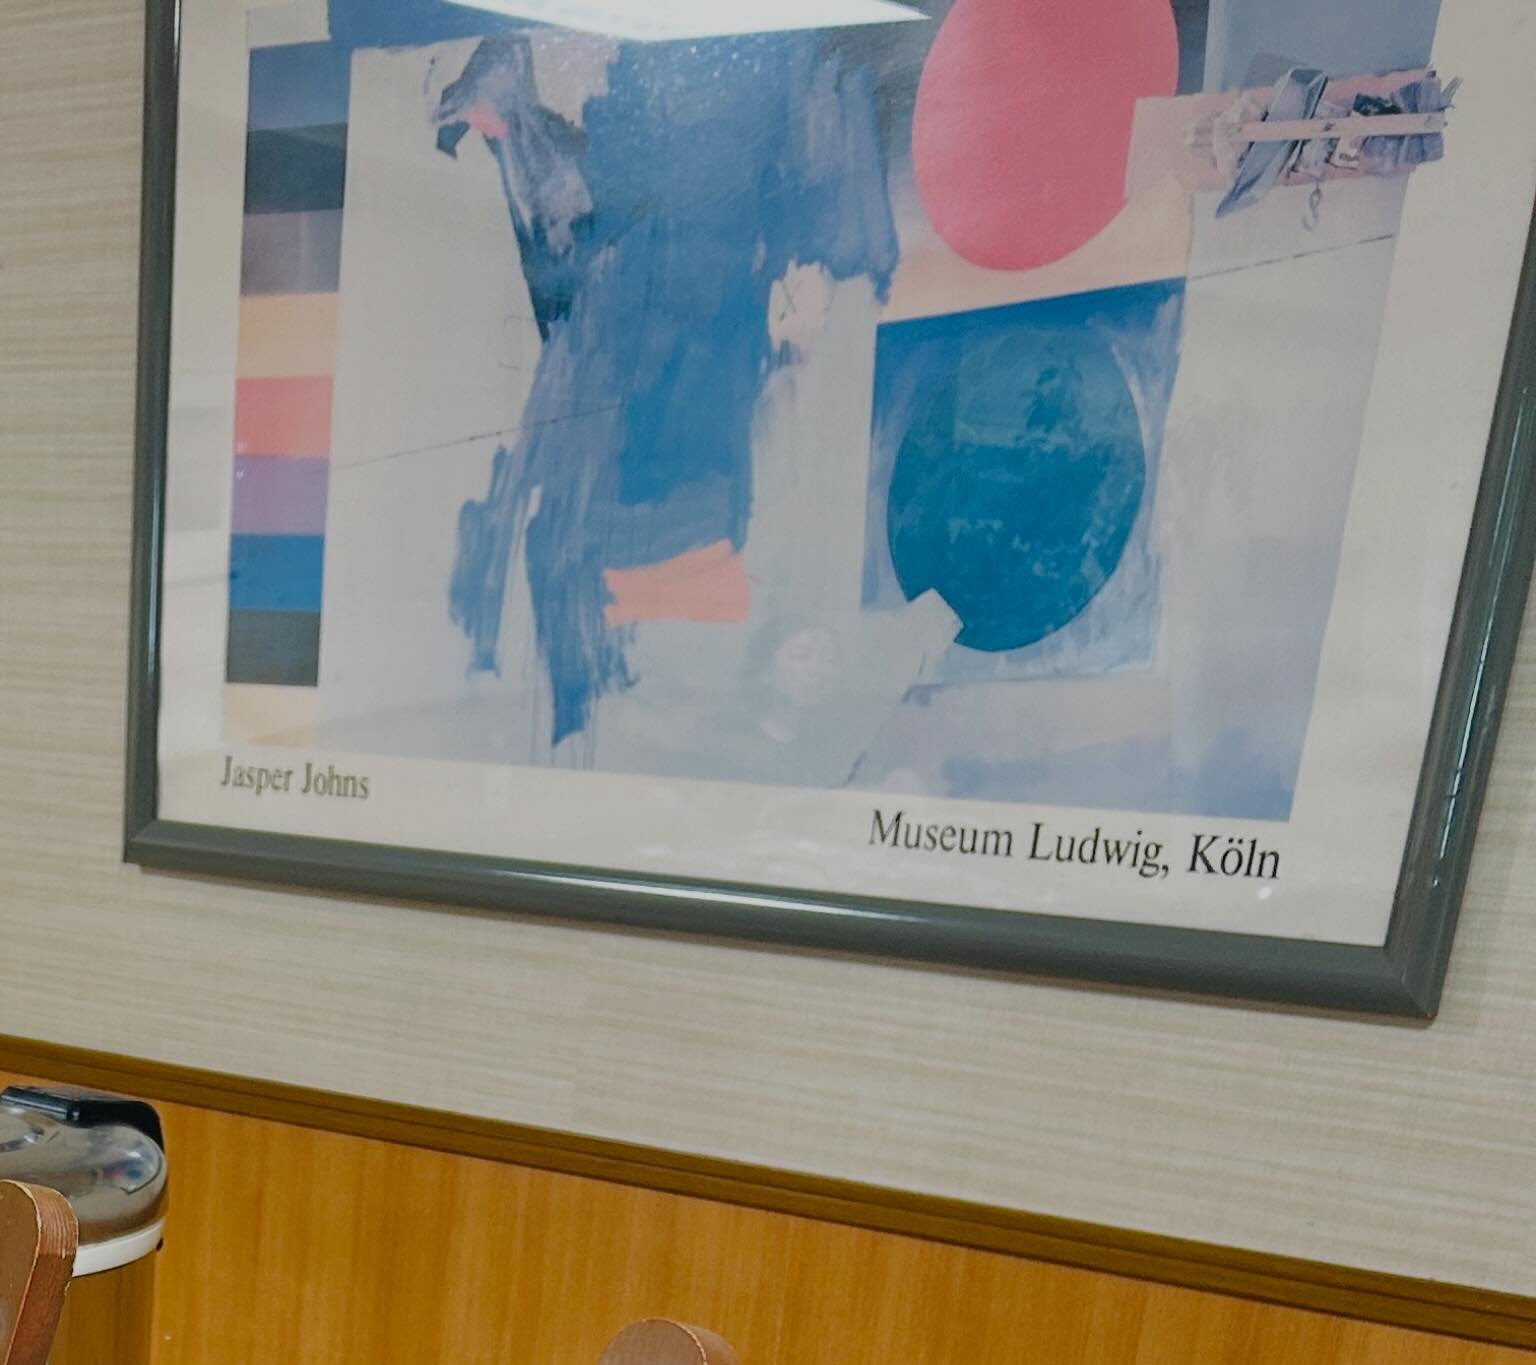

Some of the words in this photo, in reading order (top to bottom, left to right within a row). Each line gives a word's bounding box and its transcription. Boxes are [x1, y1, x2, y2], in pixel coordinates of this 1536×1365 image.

[220, 755, 294, 796] Jasper
[301, 762, 370, 800] Johns
[868, 808, 1013, 858] Museum
[1029, 822, 1170, 878] Ludwig,
[1187, 833, 1281, 879] Köln
